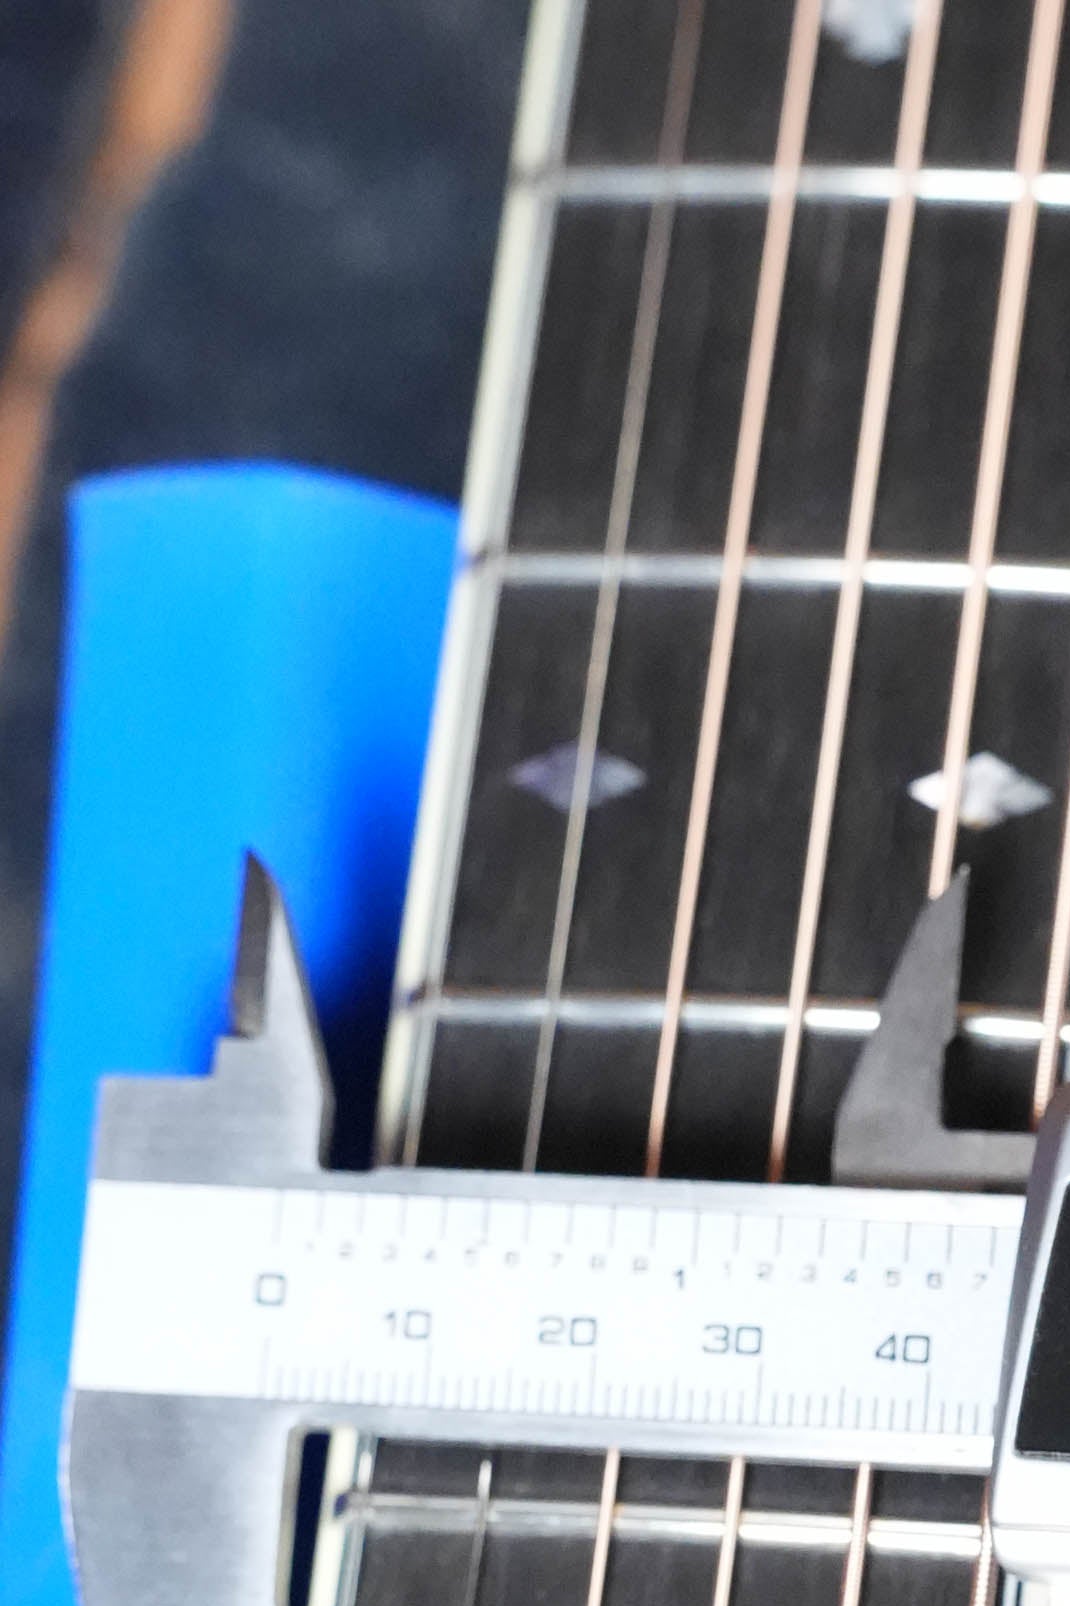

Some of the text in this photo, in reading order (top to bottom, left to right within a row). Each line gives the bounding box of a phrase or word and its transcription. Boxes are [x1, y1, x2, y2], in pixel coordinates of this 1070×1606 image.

[380, 1242, 399, 1264] 3
[462, 1246, 479, 1269] 5
[503, 1249, 521, 1269] 6
[548, 1251, 564, 1269] 7
[672, 1266, 686, 1291] 1
[755, 1260, 774, 1282] 2
[799, 1261, 818, 1284] 3
[842, 1266, 859, 1286] 4
[883, 1266, 902, 1289] 5
[925, 1269, 944, 1291] 6
[970, 1270, 988, 1292] 7
[255, 1272, 932, 1365] 0 10 20 30 40
